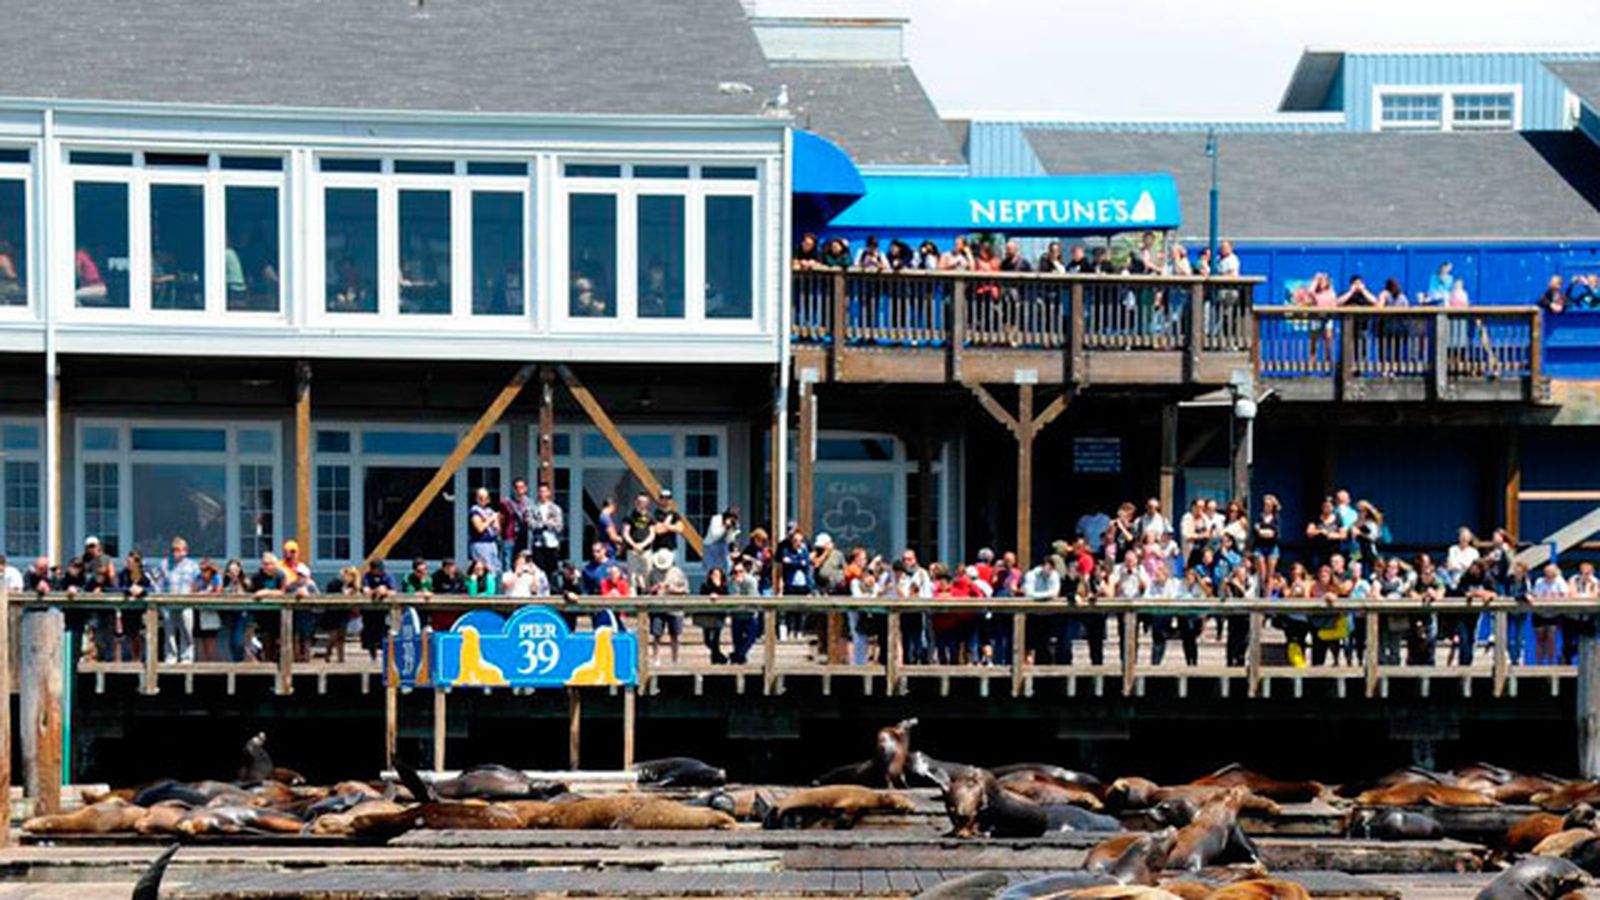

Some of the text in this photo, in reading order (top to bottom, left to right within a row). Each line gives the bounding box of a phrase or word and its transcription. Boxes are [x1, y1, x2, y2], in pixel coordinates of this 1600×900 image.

[970, 199, 1128, 223] NEPTUNE'S
[519, 623, 556, 639] PIER
[517, 639, 560, 674] 39
